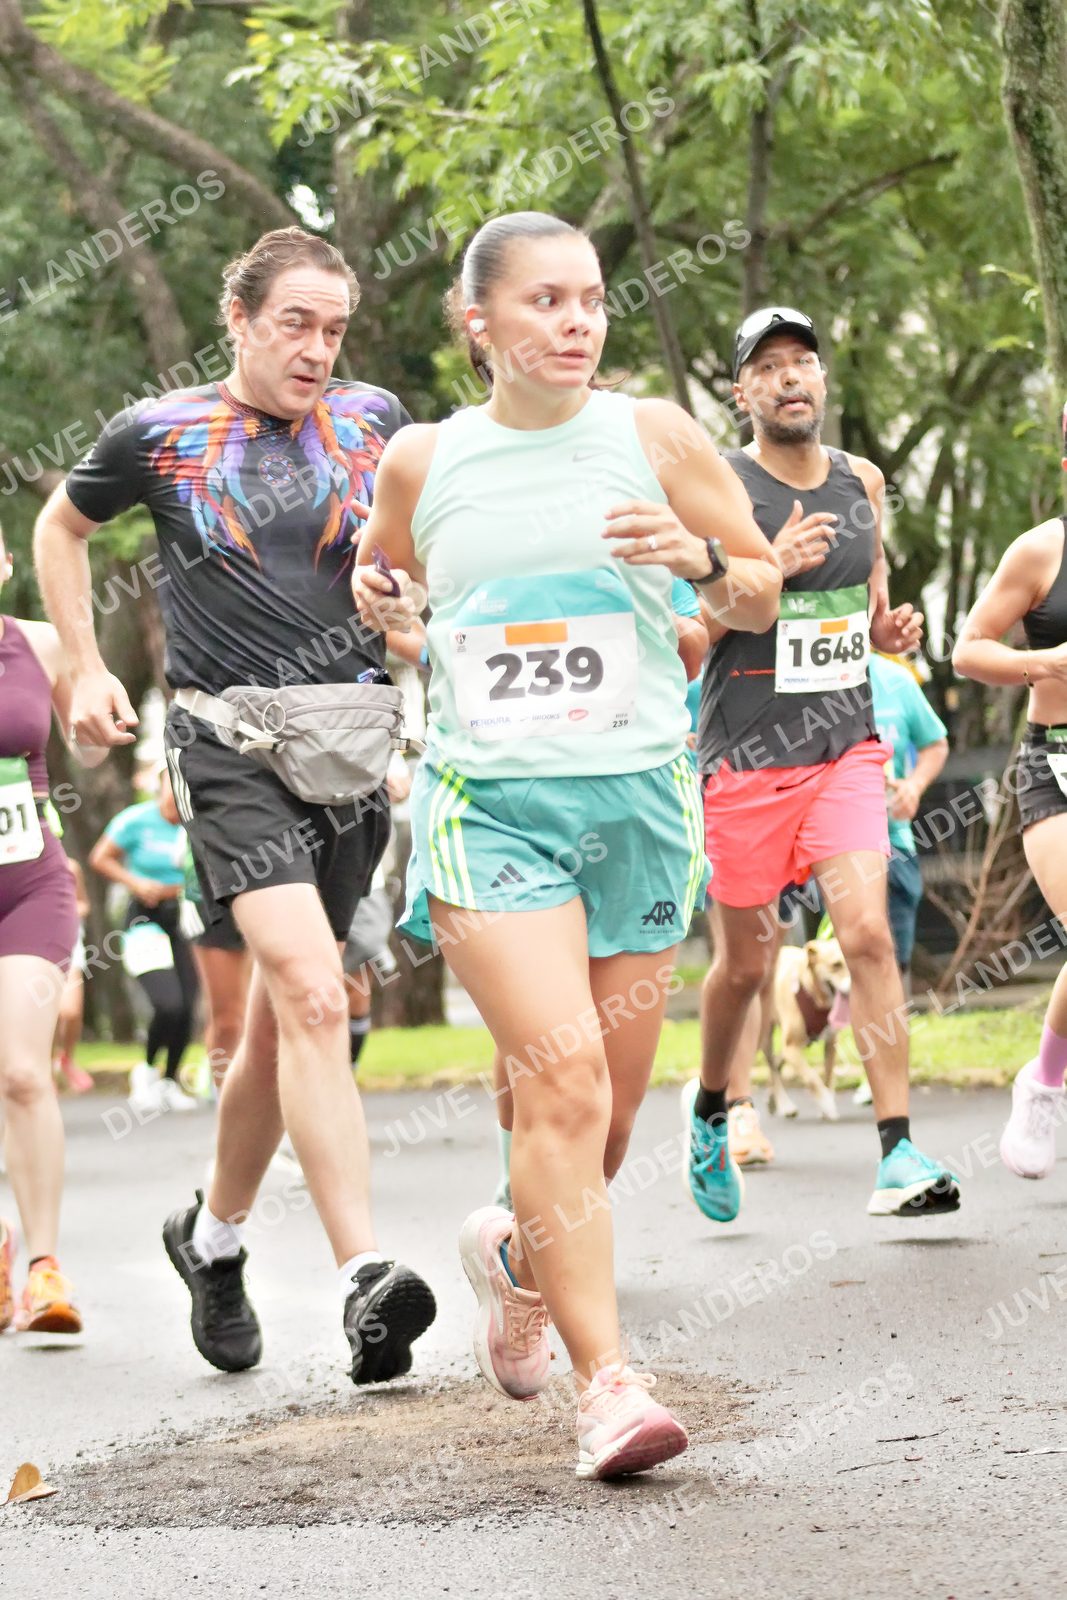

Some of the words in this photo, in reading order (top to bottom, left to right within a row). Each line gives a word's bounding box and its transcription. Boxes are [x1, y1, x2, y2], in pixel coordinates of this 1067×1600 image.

[788, 632, 864, 667] 1648
[485, 646, 604, 701] 239
[612, 719, 629, 728] 239
[641, 901, 676, 926] AR
